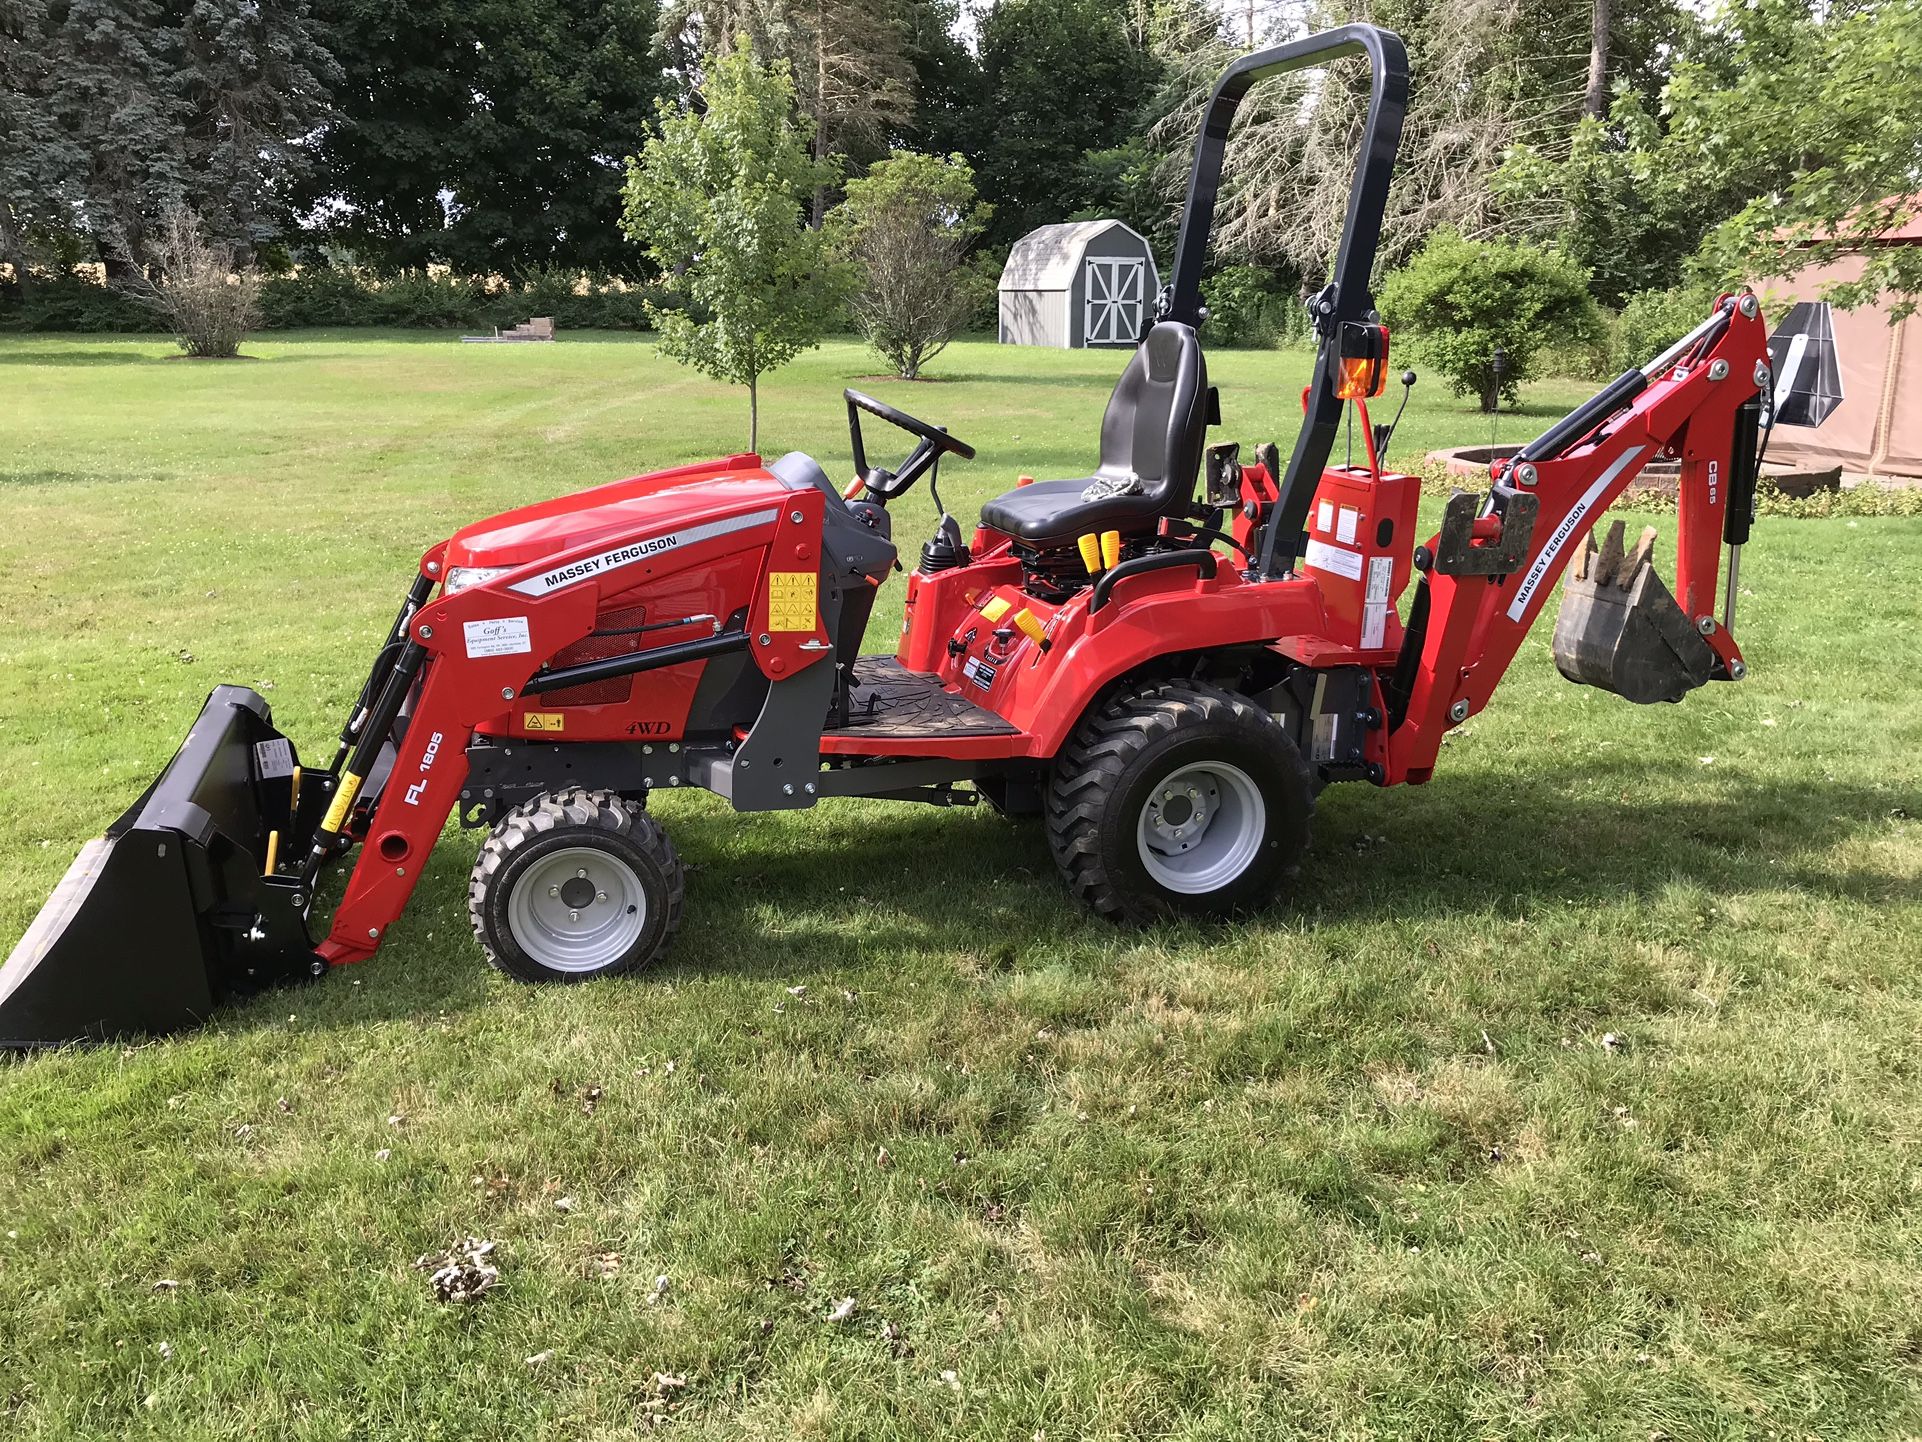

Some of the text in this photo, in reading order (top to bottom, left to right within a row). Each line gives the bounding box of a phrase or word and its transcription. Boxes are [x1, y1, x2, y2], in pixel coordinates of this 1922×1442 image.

[545, 536, 677, 587] MASSEY FERGUSON
[1518, 503, 1586, 603] MASSEY FERGUSON
[624, 720, 671, 735] 4WD
[404, 731, 443, 806] FL 1805
